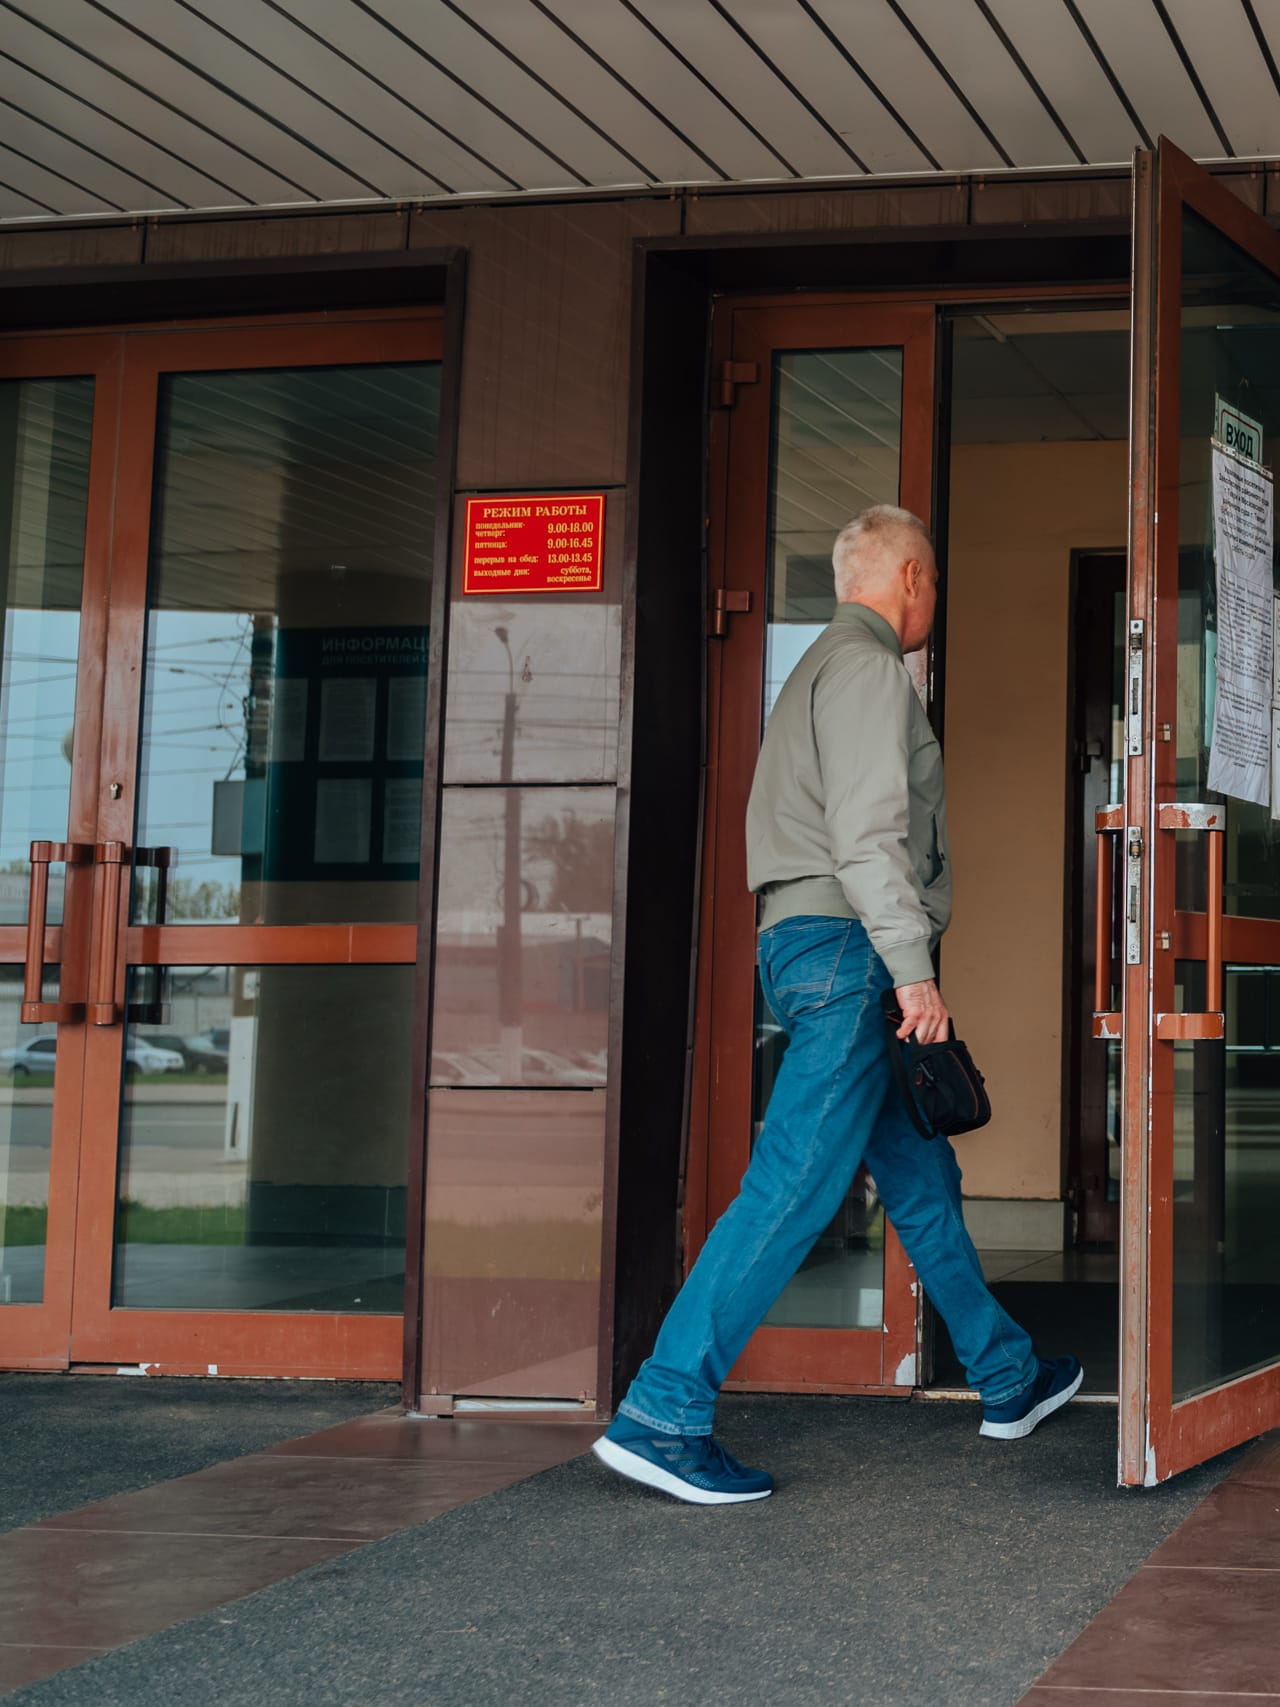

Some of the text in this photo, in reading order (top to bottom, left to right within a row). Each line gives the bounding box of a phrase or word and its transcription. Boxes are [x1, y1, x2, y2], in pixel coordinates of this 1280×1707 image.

[1226, 422, 1254, 460] ВХОД
[483, 504, 587, 518] РЕЖИМ РАБОТЫ
[547, 522, 594, 533] 9.00-18.00
[547, 537, 593, 549] 9.00-16.45
[548, 553, 593, 564] 13.00-13.45
[322, 637, 430, 652] ИНФОРМАЦ
